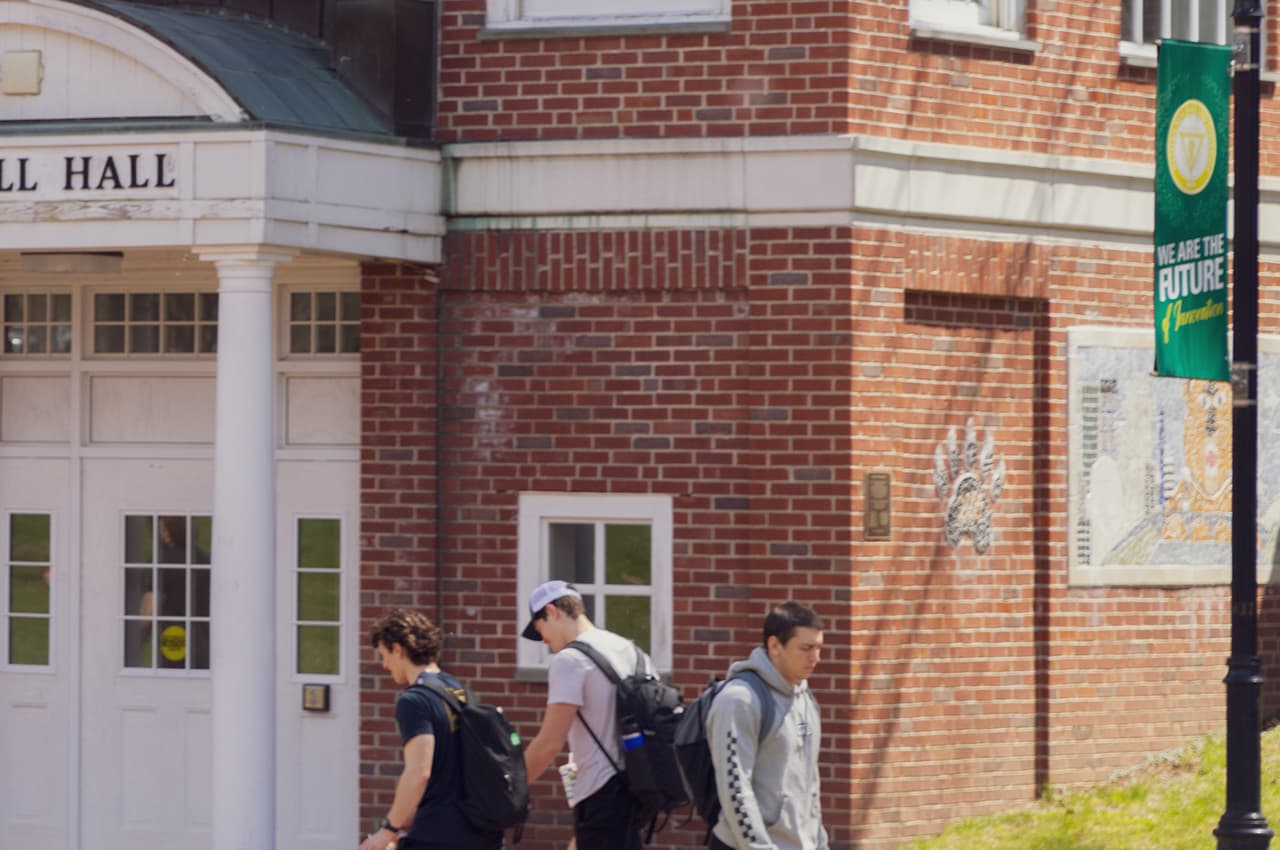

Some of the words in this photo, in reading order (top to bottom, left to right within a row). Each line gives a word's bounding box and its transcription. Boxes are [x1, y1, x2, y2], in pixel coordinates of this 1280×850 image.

[63, 153, 176, 191] HALL
[1158, 243, 1175, 265] WE
[1178, 238, 1200, 261] ARE
[1204, 233, 1224, 256] THE
[1160, 256, 1224, 302] FUTURE
[1174, 299, 1223, 331] Innovation
